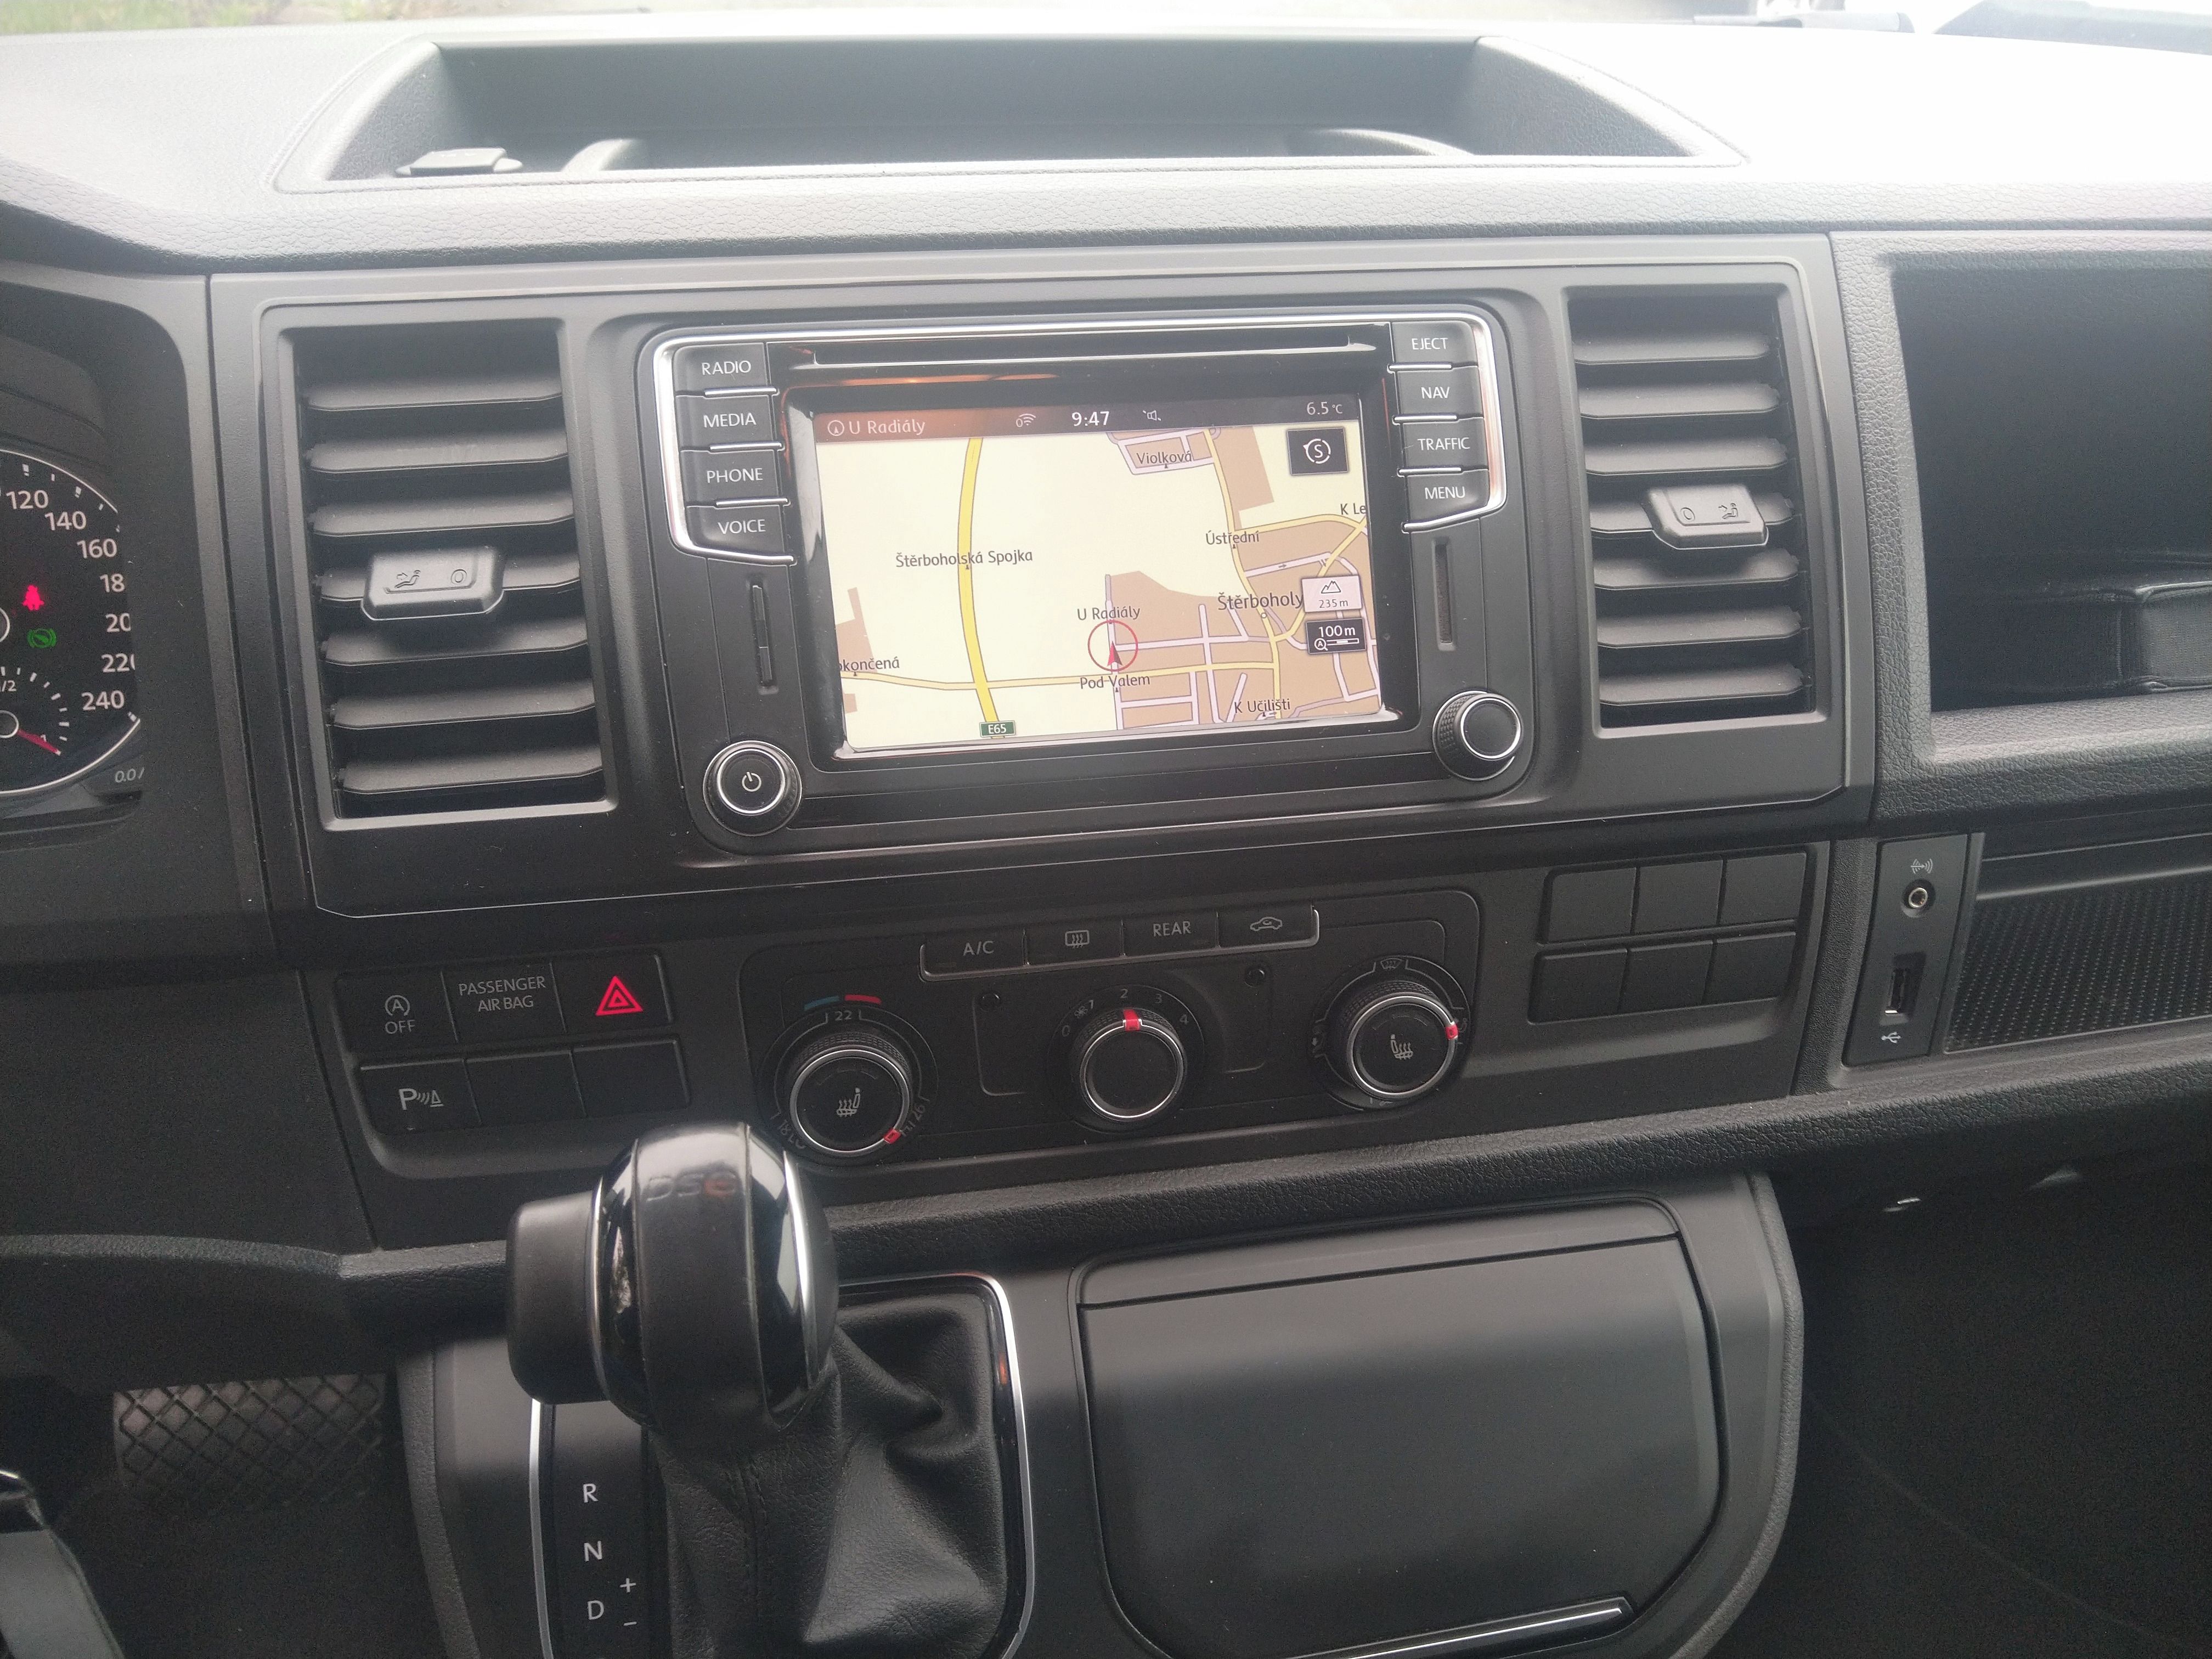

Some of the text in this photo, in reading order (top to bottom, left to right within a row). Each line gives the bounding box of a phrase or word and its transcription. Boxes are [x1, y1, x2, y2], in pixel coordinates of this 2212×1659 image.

[1411, 337, 1448, 350] EJECT
[702, 360, 752, 375] RADIO
[1420, 386, 1450, 399] NAV
[703, 413, 757, 428] MEDIA
[1071, 411, 1110, 427] 9:47
[849, 419, 926, 436] U Radiály
[1417, 437, 1470, 450] TRAFFIC
[1136, 450, 1193, 465] Violková
[707, 468, 764, 483] PHONE
[7, 489, 48, 510] 120
[1424, 486, 1465, 499] MENU
[1340, 503, 1349, 515] K
[44, 511, 87, 531] 140
[718, 519, 766, 534] VOICE
[1205, 530, 1260, 545] Ústřední
[77, 538, 117, 558] 160
[895, 549, 1033, 567] Štěrboholská Spojka
[1077, 606, 1141, 620] U Radiály
[1080, 675, 1150, 690] Pod Valem
[81, 690, 125, 711] 240
[1234, 698, 1291, 713] K Učilišti
[988, 724, 1007, 734] E65
[1153, 921, 1191, 938] REAR
[963, 940, 995, 956] A/C
[458, 975, 546, 997] PASSENGER
[1120, 988, 1128, 999] 2
[1088, 999, 1094, 1009] 1
[1154, 993, 1163, 1004] 3
[834, 1010, 853, 1021] 22
[1180, 1014, 1189, 1025] 4
[385, 1019, 416, 1035] OFF
[583, 1483, 599, 1503] R
[583, 1541, 603, 1562] N
[587, 1600, 604, 1621] D
